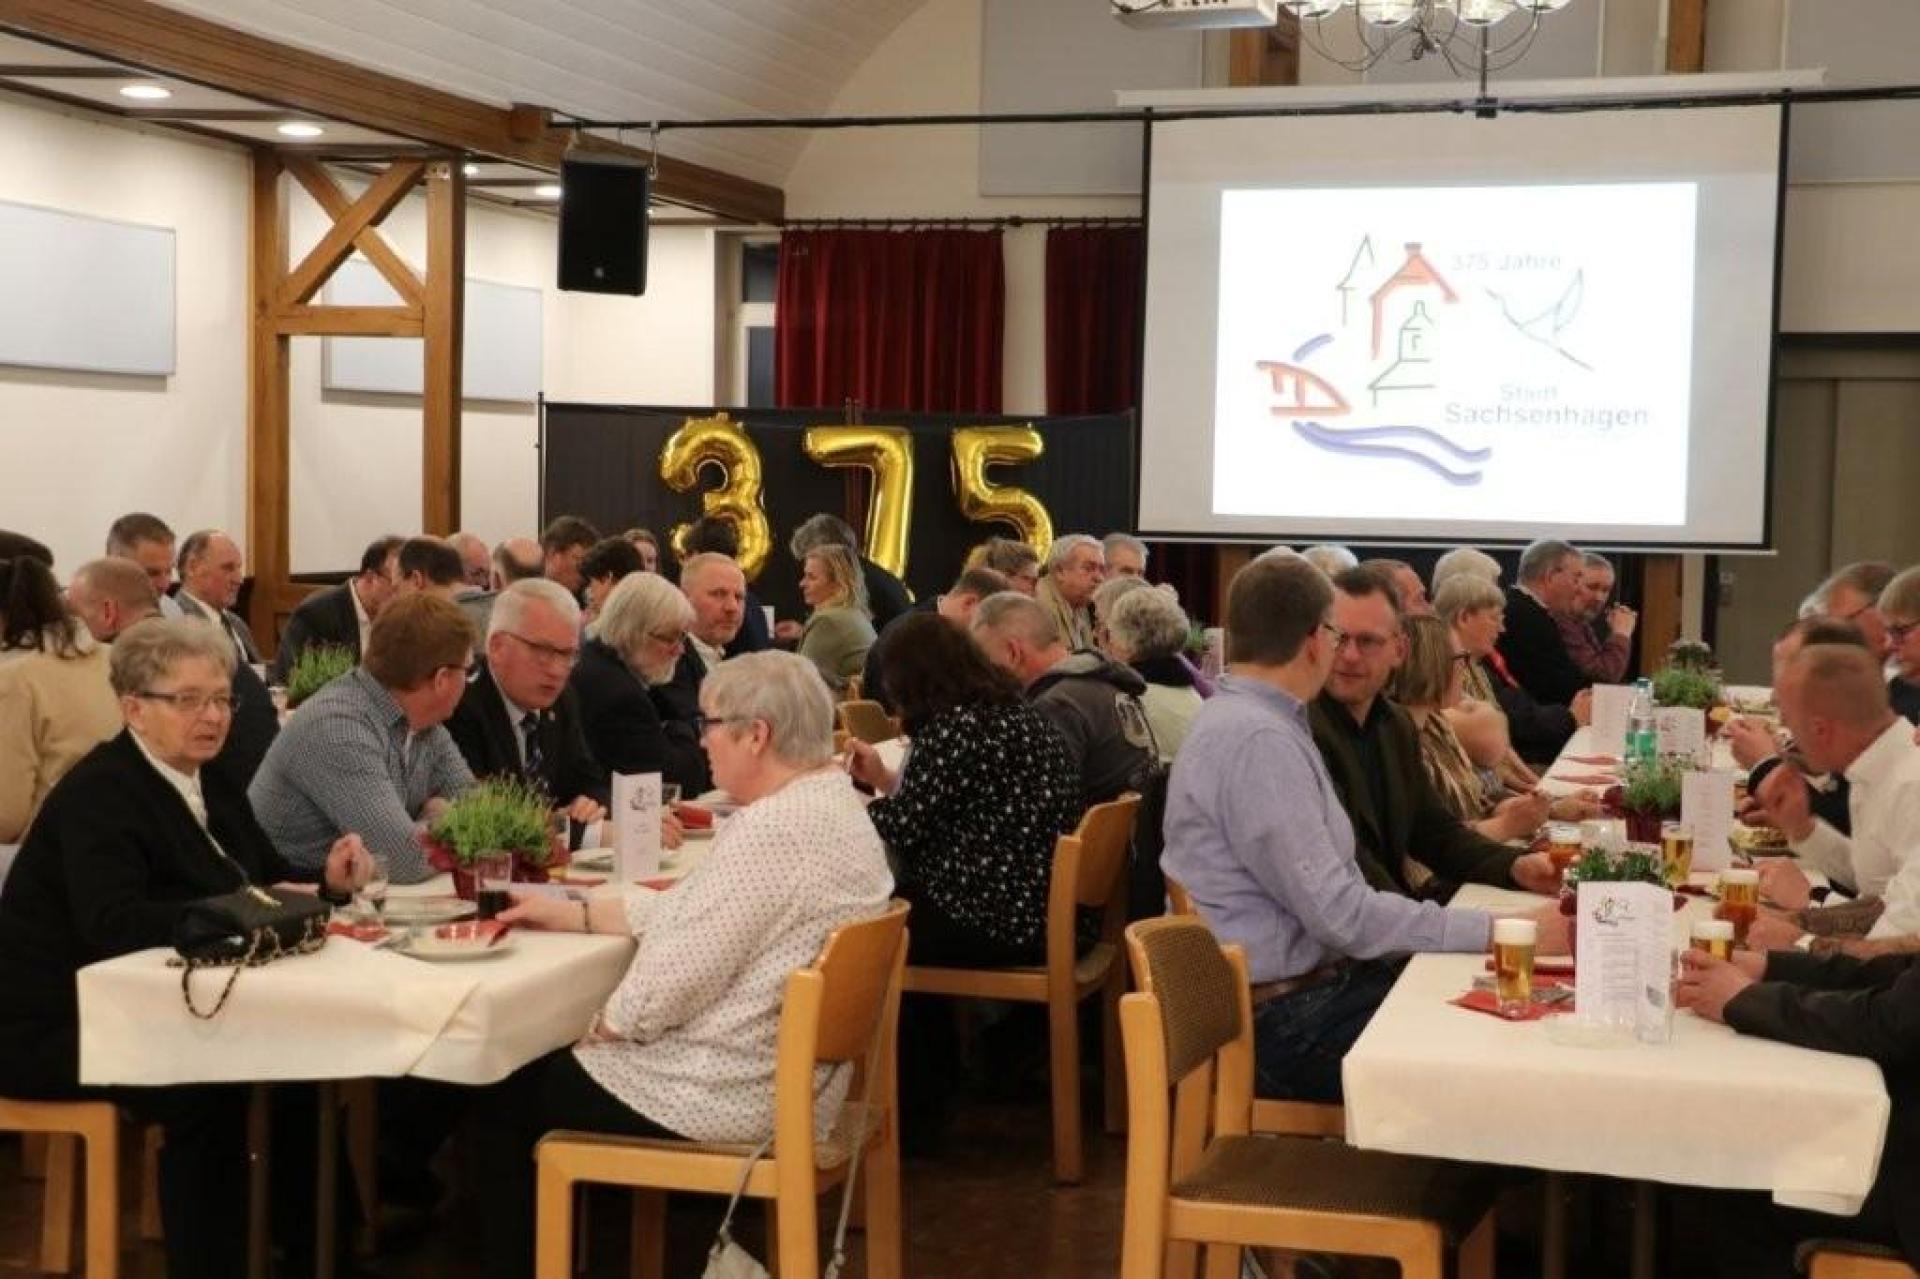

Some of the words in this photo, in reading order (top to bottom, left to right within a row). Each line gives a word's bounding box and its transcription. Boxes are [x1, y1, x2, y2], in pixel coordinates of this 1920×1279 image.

[1453, 253, 1489, 271] 375
[1497, 253, 1561, 271] Jahre
[1445, 402, 1650, 431] Sachsenhagen
